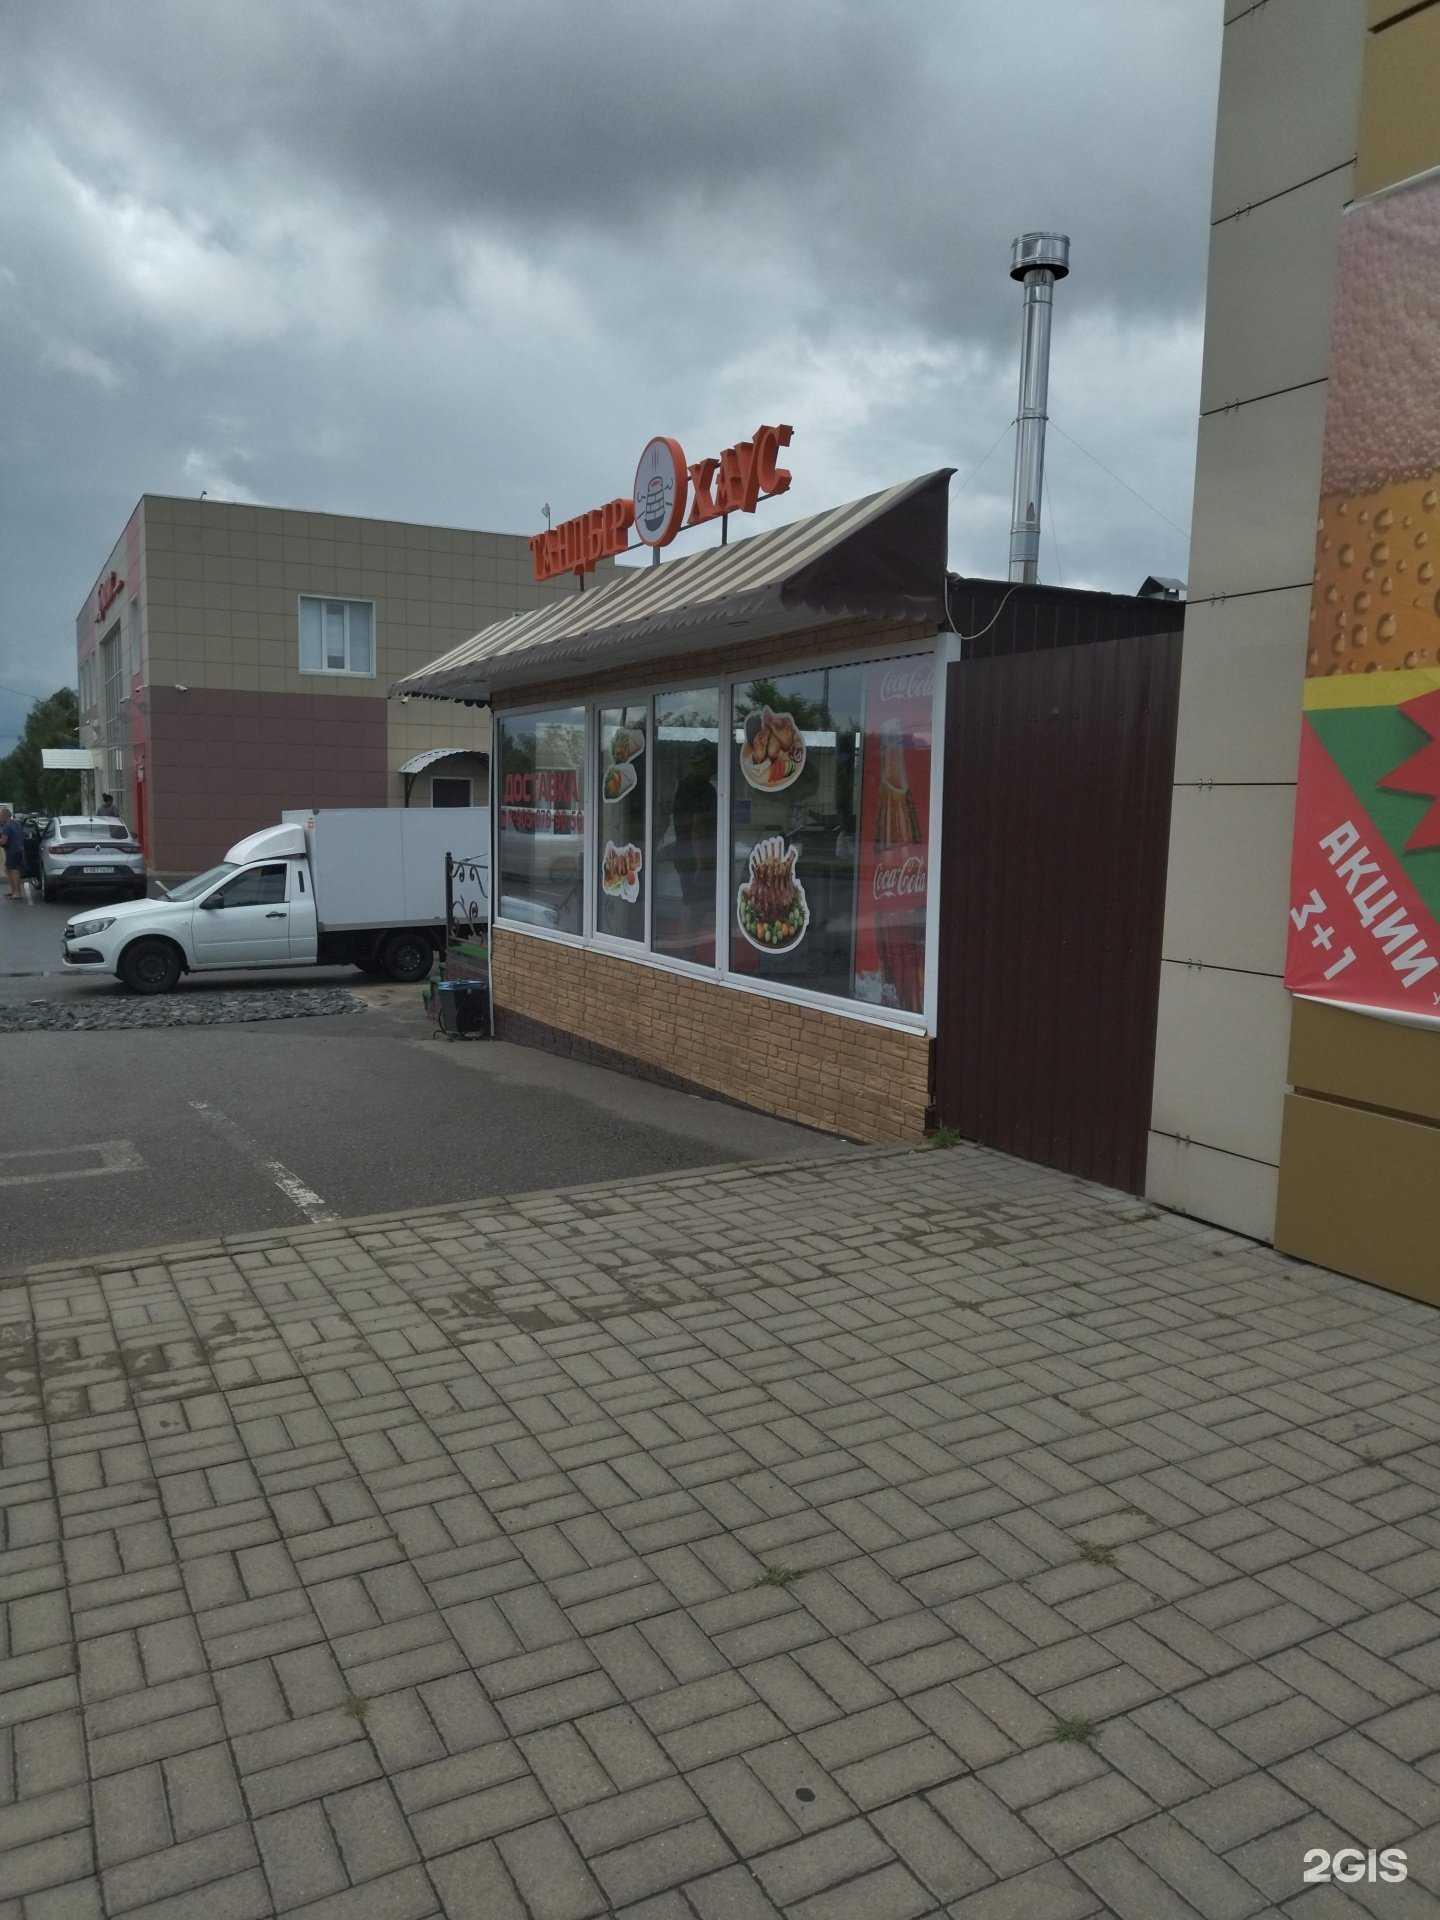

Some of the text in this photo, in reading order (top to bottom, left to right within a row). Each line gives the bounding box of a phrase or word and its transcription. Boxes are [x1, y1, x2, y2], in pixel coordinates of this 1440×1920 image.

[528, 424, 793, 581] ТАНДЫР ХАУС
[504, 772, 582, 804] ДОСТАВКА
[1290, 889, 1356, 981] 3+1
[1319, 820, 1438, 988] АКЦИИ
